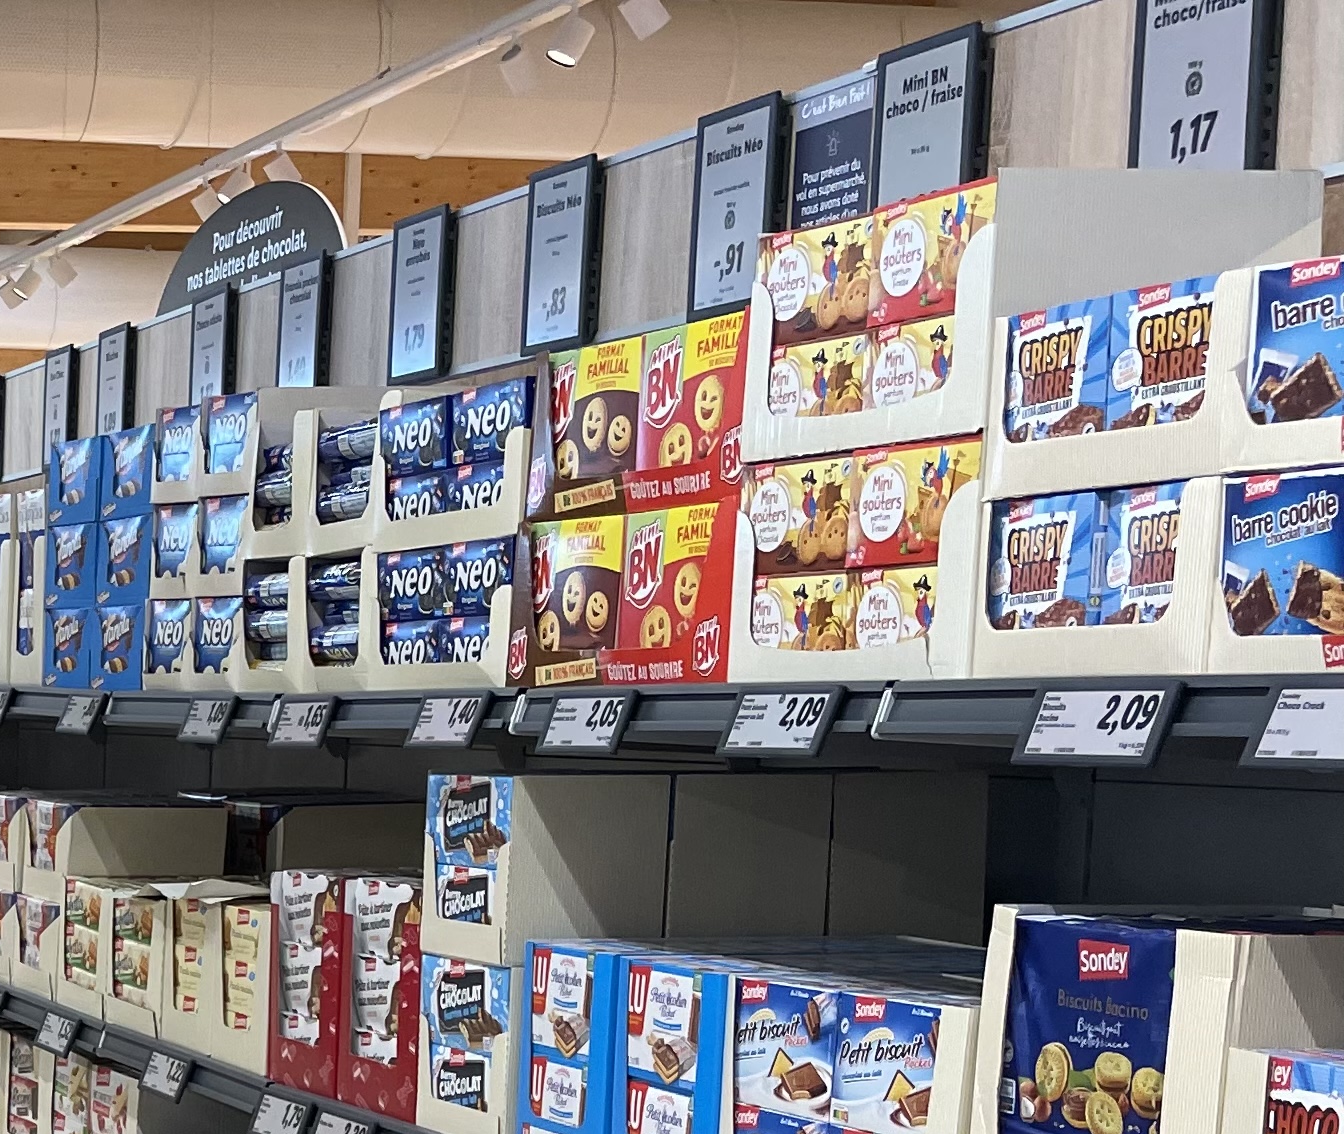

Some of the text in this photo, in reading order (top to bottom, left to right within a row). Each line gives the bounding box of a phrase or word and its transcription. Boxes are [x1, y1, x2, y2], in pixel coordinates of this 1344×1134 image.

[902, 65, 949, 95] Mini BN
[885, 99, 920, 121] choco
[930, 83, 964, 107] fraise
[706, 137, 763, 167] Biscuits Néo
[1169, 109, 1219, 165] 1,17
[802, 157, 861, 185] Pour prévenir du
[213, 205, 284, 255] Pour découvrir
[892, 226, 915, 247] Mini
[186, 269, 204, 293] nos
[204, 254, 246, 287] tablettes
[246, 246, 260, 267] de
[260, 227, 308, 265] chocolat,
[882, 246, 922, 270] goûters
[1138, 286, 1171, 307] Sondey
[596, 343, 626, 360] FORMAT
[1020, 325, 1083, 376] CRISPY
[586, 359, 630, 380] FAMILIAL
[646, 353, 682, 411] BN
[1022, 367, 1076, 405] BARRE
[464, 399, 511, 440] Neo
[629, 470, 712, 499] GOÛTEZ AU SOURIRE
[1232, 490, 1339, 545] barre cookie
[1265, 529, 1302, 547] chocolat
[454, 557, 497, 592] Neo
[447, 698, 480, 729] 1,40
[585, 699, 624, 732] 2,05
[778, 696, 827, 732] 2,09
[1096, 694, 1161, 736] 2,09
[1080, 948, 1129, 976] Sondey
[628, 971, 648, 1015] LU
[1057, 989, 1149, 1020] Biscuits Bacino
[855, 1000, 885, 1019] Sondey
[839, 1034, 925, 1066] Petit biscuit
